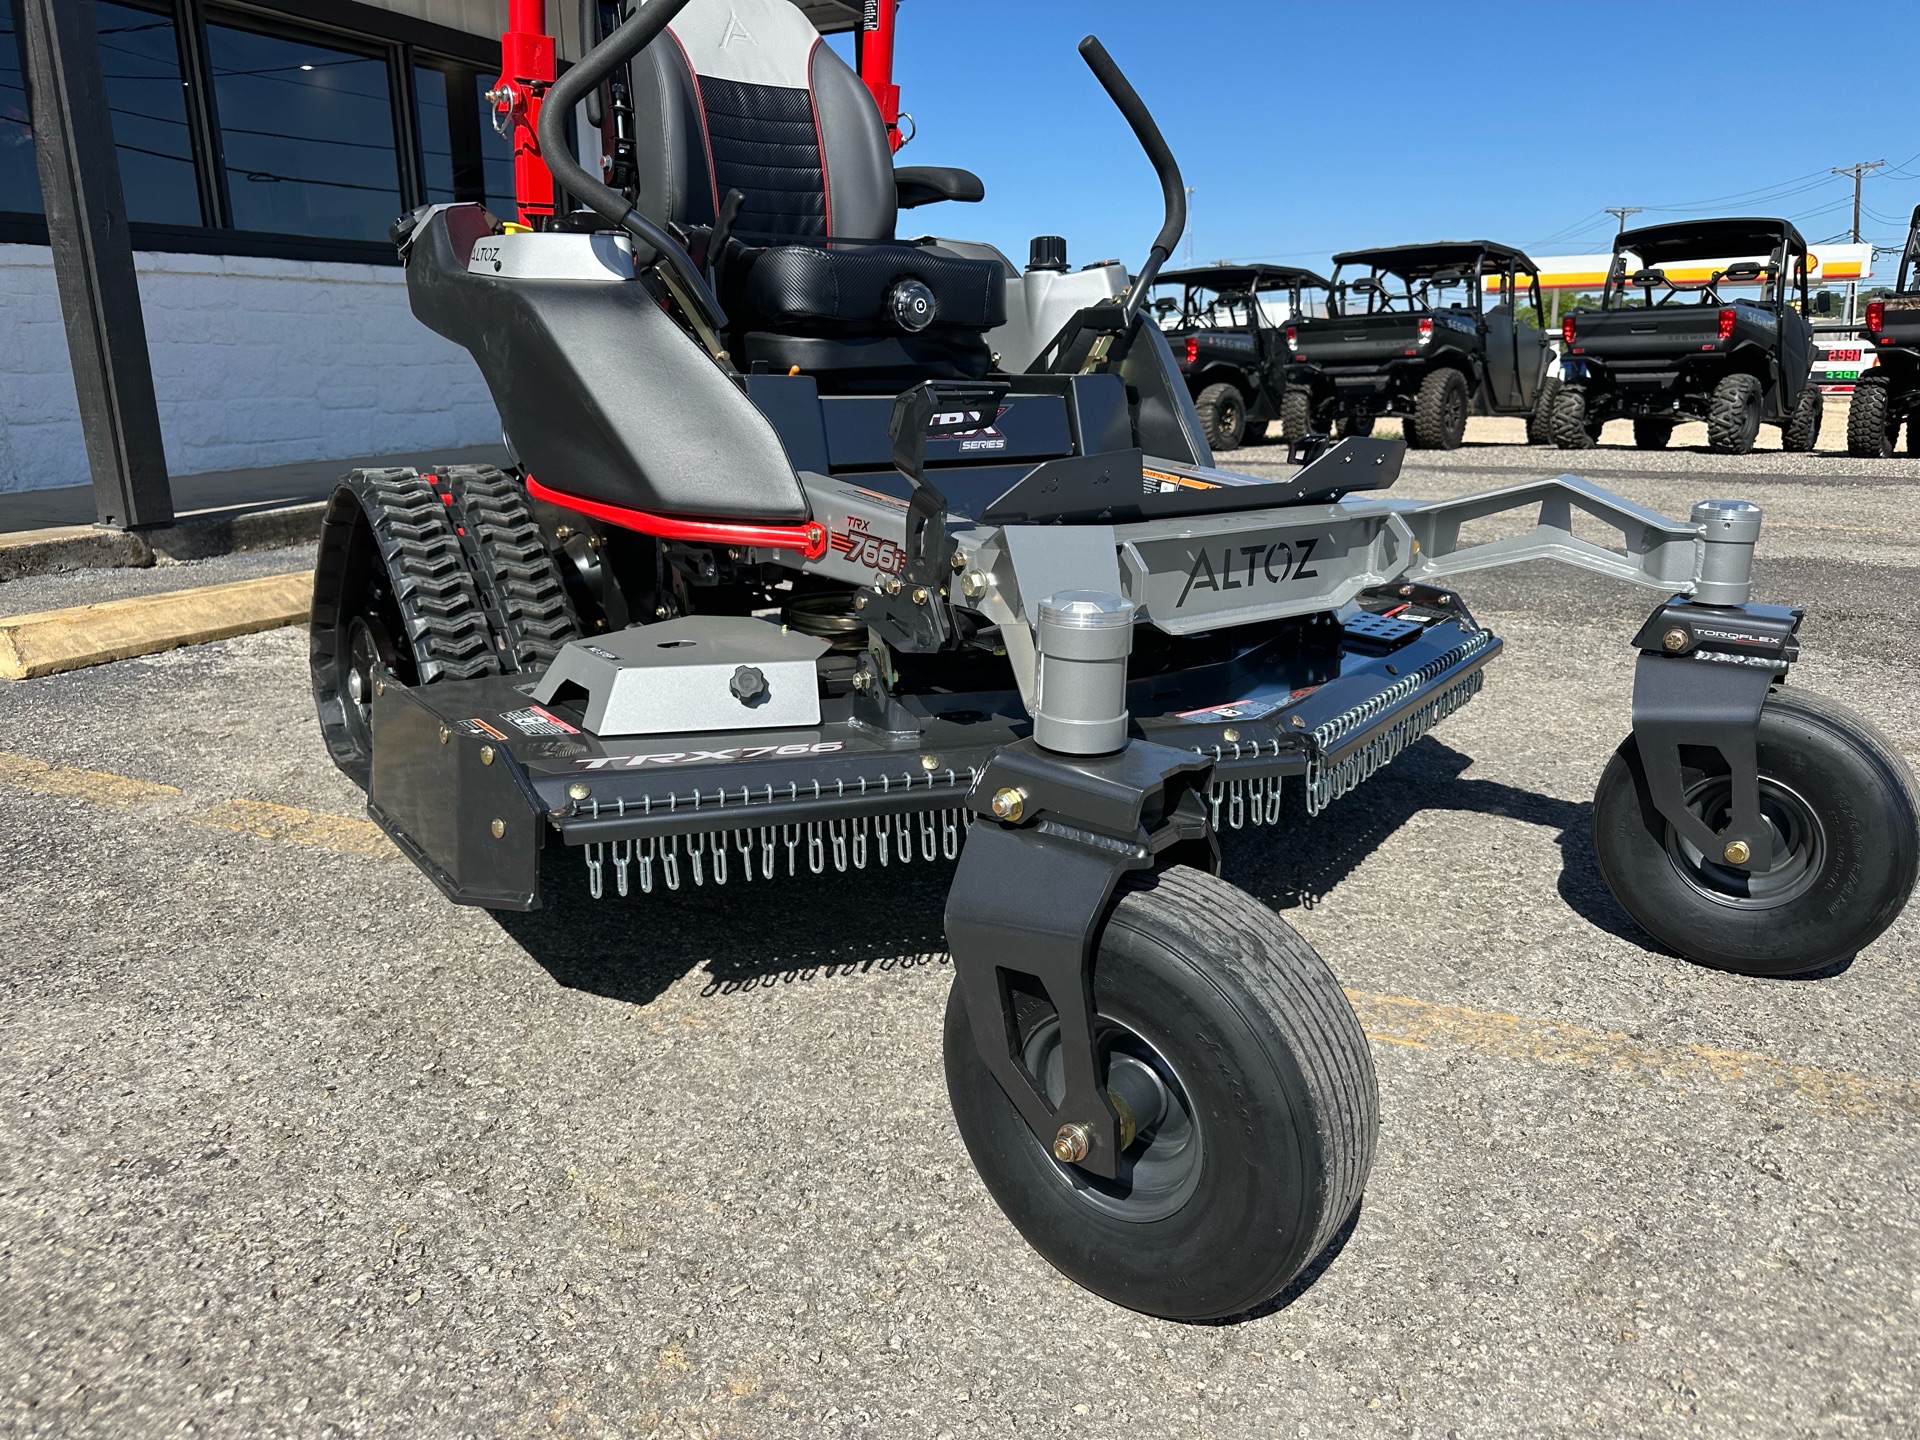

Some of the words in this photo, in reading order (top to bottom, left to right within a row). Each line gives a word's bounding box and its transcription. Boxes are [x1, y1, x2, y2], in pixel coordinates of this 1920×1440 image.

[470, 247, 500, 262] ALTOZ
[962, 439, 1005, 450] SERIES
[846, 515, 871, 532] TRX
[844, 529, 903, 575] 766i
[1175, 538, 1319, 608] ALTOZ
